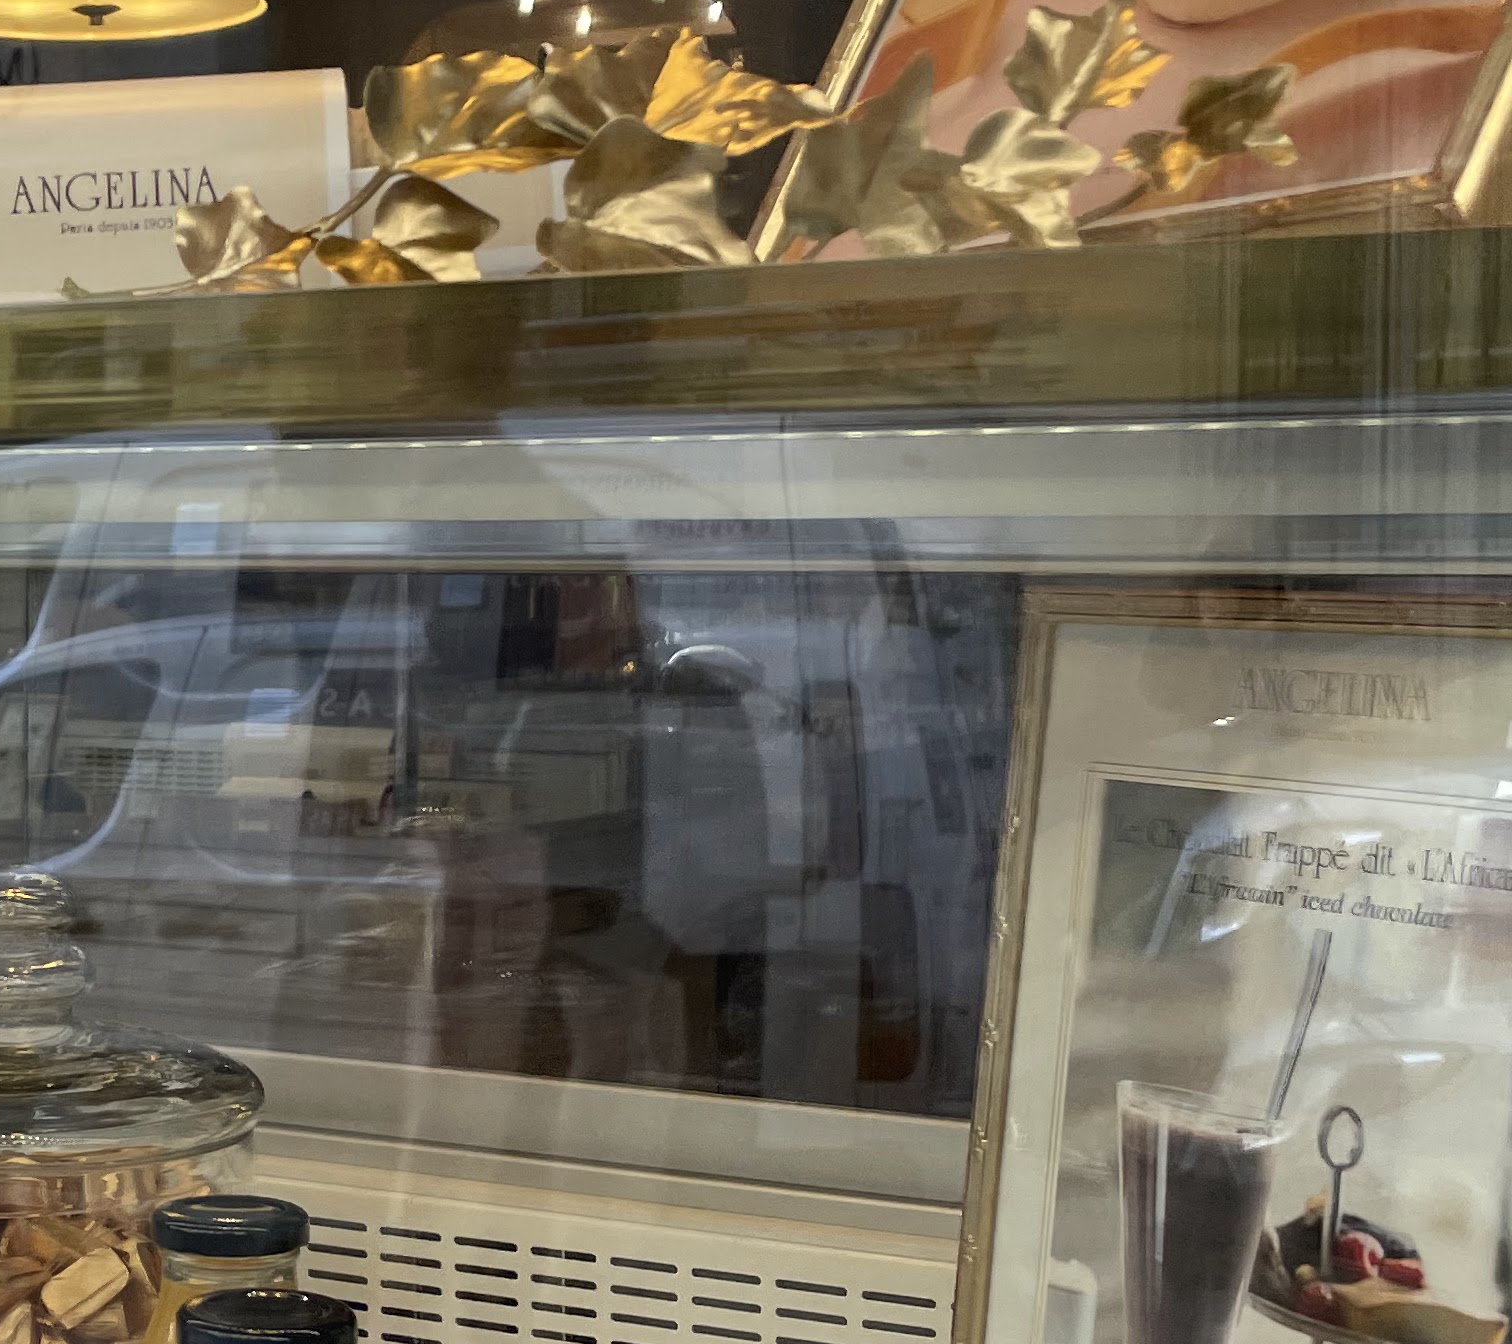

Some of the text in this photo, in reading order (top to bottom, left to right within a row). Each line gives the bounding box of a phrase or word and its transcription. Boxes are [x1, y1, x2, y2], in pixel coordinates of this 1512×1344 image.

[10, 164, 219, 215] ANGELINA
[1236, 666, 1433, 722] ANGELINA
[1361, 842, 1396, 877] dit
